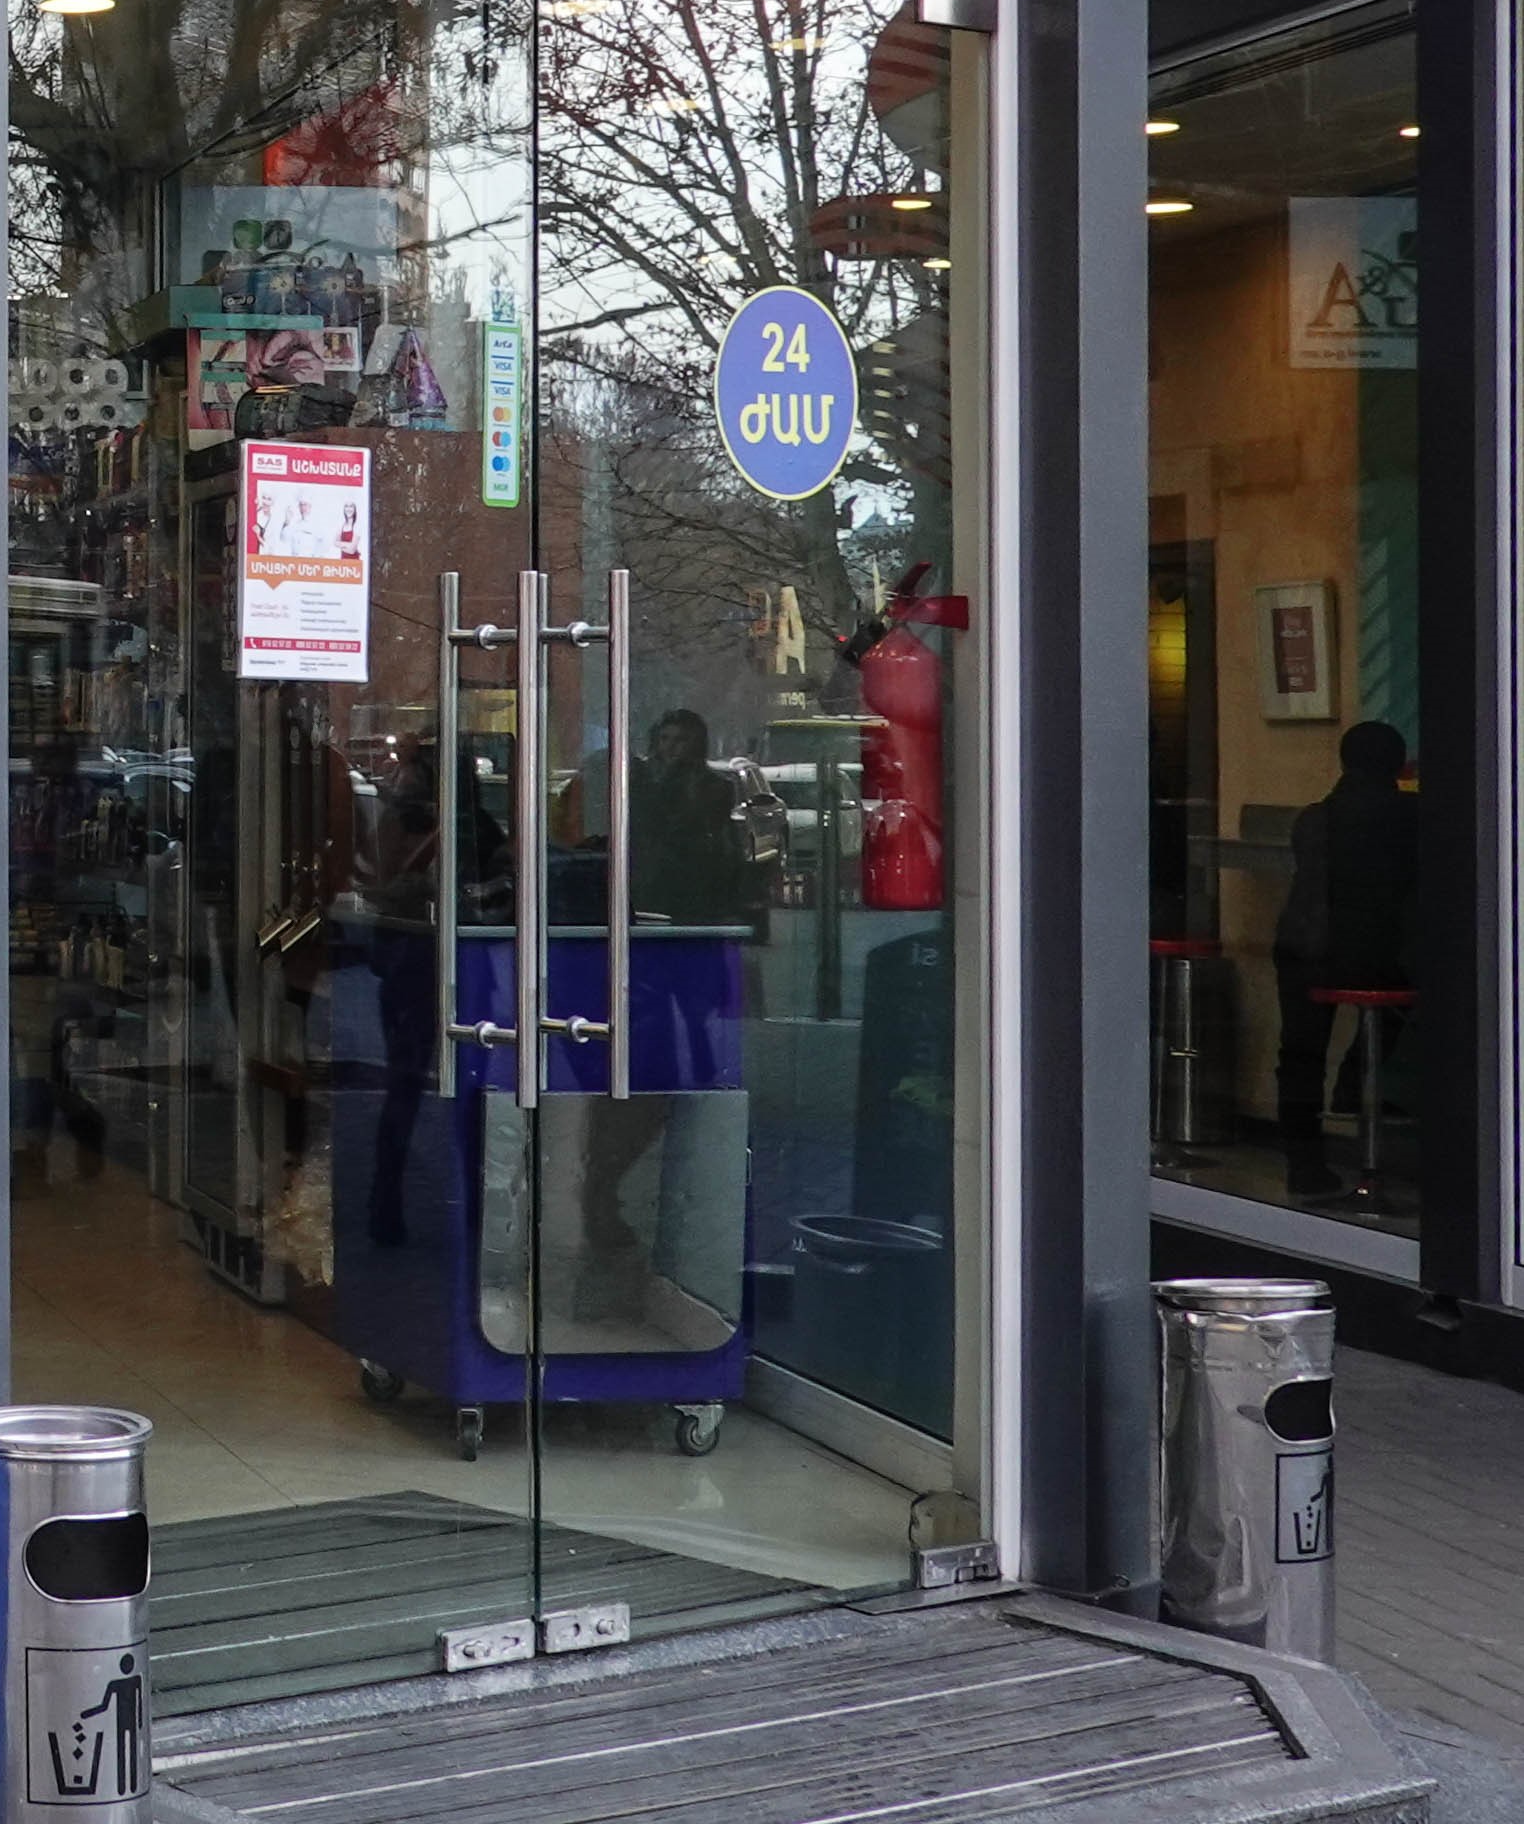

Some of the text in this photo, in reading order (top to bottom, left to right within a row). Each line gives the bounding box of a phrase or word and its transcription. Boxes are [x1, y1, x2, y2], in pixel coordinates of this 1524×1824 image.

[761, 321, 811, 374] 24
[493, 362, 512, 371] VISA
[493, 386, 512, 395] VISA
[739, 395, 835, 447] ԺԱՄ
[257, 457, 283, 466] SAS
[291, 459, 361, 477] ԱՇԽԱՏԱՆՔ
